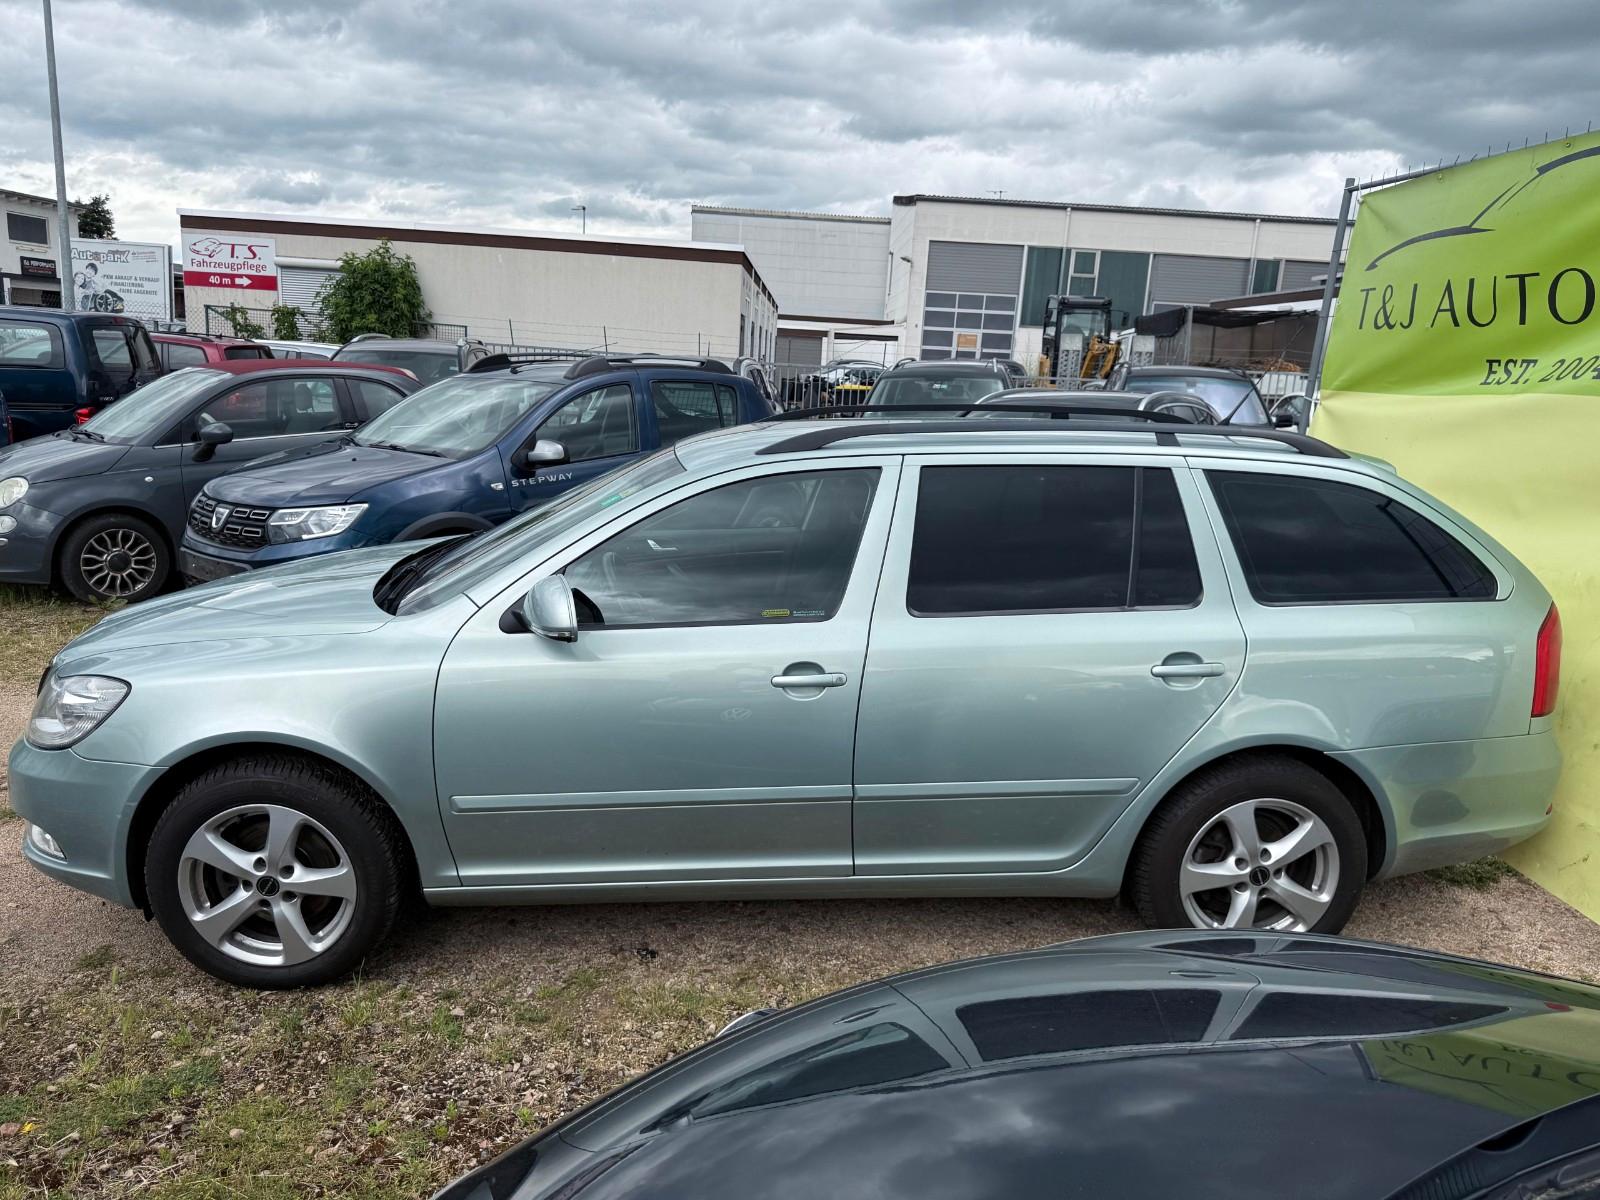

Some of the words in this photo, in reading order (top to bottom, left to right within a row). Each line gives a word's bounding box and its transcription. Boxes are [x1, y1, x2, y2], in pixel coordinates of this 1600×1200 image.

[191, 258, 267, 273] Fahrzeugpflege
[209, 275, 220, 285] 40
[1358, 283, 1418, 330] T&J
[1430, 267, 1596, 328] AUTO
[1479, 358, 1539, 386] EST.
[511, 472, 573, 487] STEPWAY
